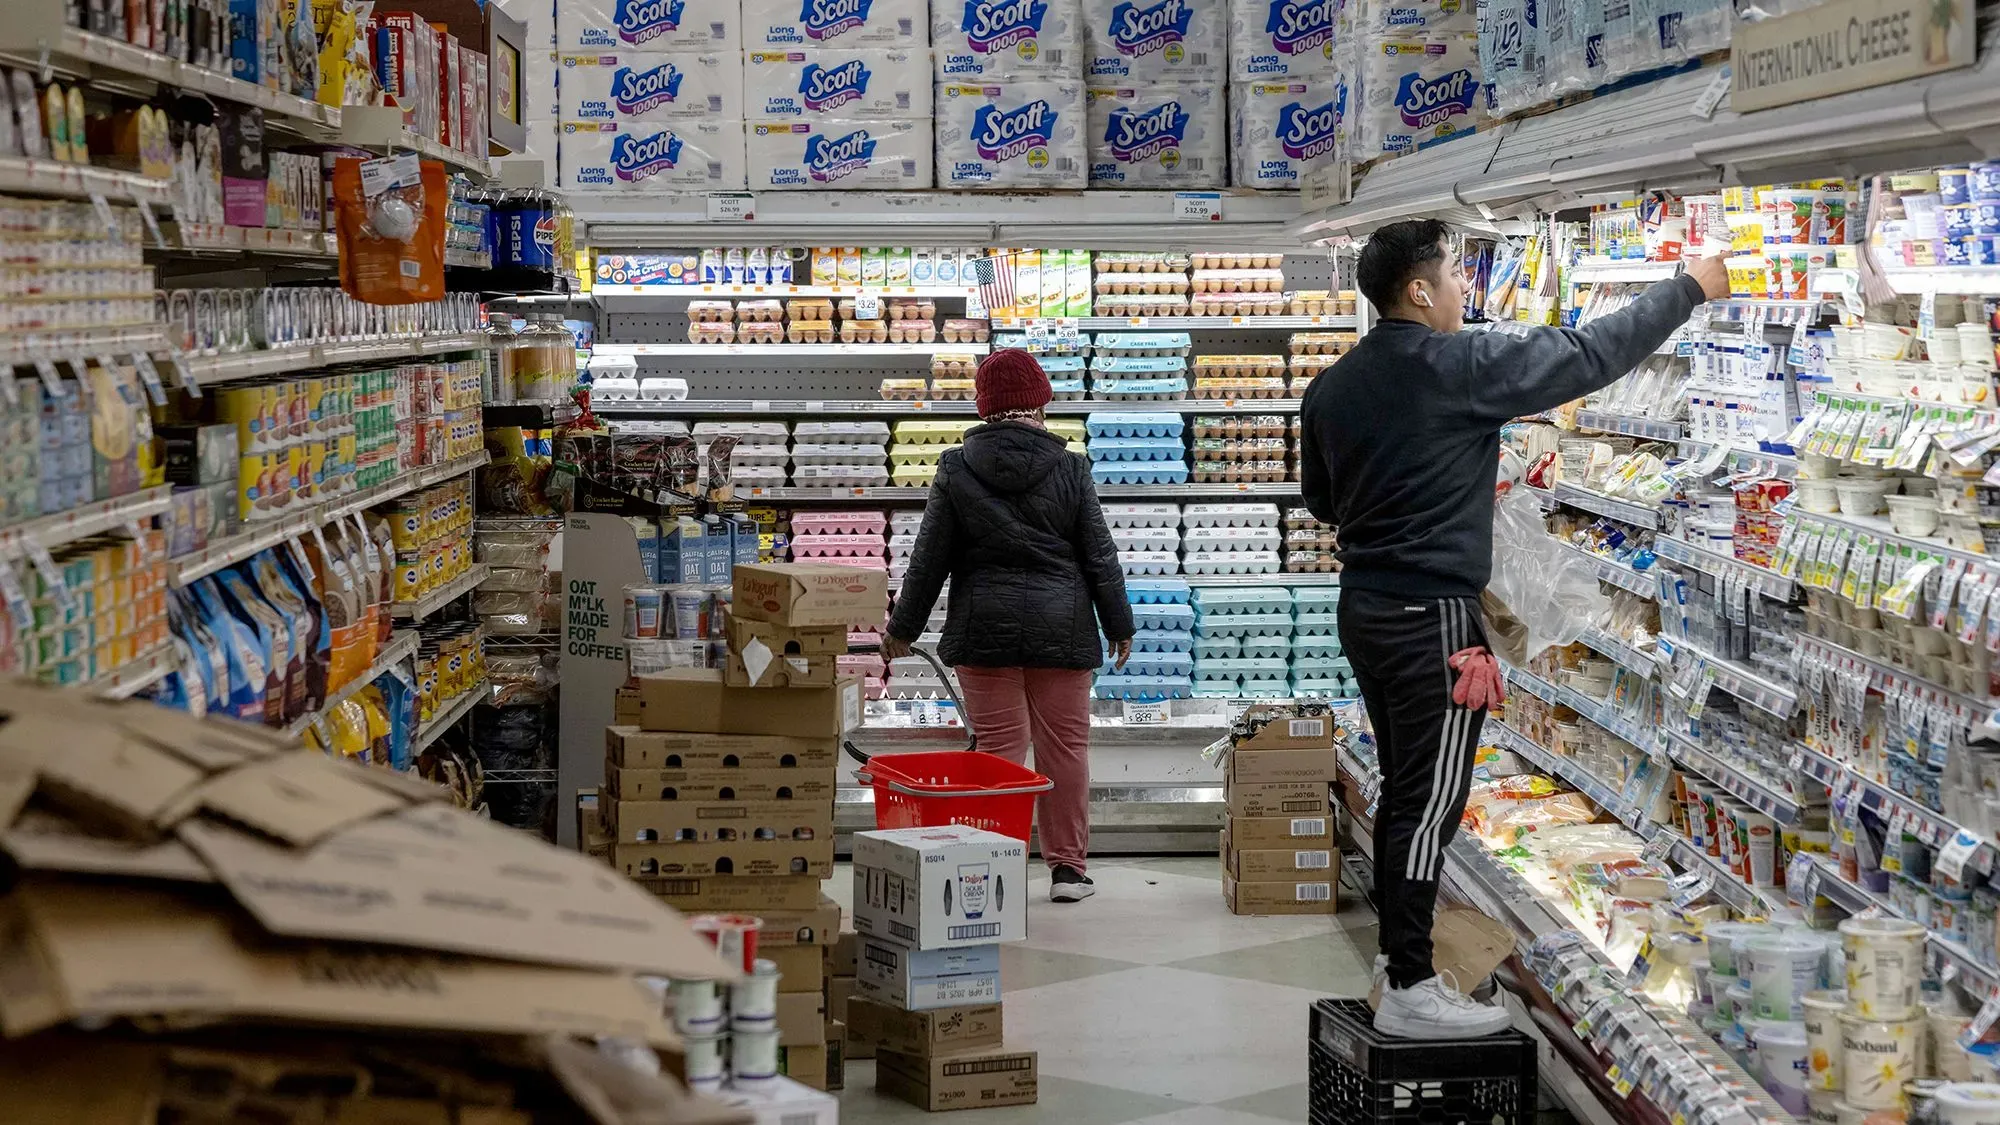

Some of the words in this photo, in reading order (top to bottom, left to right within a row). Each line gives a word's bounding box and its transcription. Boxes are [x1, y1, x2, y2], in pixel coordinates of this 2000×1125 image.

[622, 0, 672, 30] Scott
[1391, 8, 1417, 17] Long
[972, 0, 1034, 38] Scott
[1119, 0, 1181, 41] Scott
[1387, 15, 1426, 26] Lasting
[583, 28, 609, 39] Long
[634, 25, 662, 45] 1000
[769, 26, 795, 35] Long
[821, 21, 848, 41] 1000
[579, 37, 617, 47] Lasting
[766, 34, 803, 43] Lasting
[987, 32, 1017, 55] 1000
[1132, 35, 1165, 57] 1000
[1292, 33, 1323, 56] 1000
[1385, 46, 1398, 55] 36
[1737, 30, 1843, 91] INTERNATIONAL
[1847, 10, 1911, 66] CHEESE
[564, 58, 576, 67] 20
[946, 55, 974, 64] Long
[1094, 57, 1120, 67] Long
[1251, 55, 1278, 65] Long
[943, 64, 983, 74] Lasting
[1090, 66, 1129, 76] Lasting
[1248, 64, 1288, 74] Lasting
[620, 63, 673, 101] Scott
[809, 60, 861, 98] Scott
[949, 88, 960, 97] 36
[1405, 69, 1468, 112] Scott
[581, 100, 607, 110] Long
[632, 98, 660, 116] 1000
[768, 97, 794, 106] Long
[819, 95, 847, 114] 1000
[578, 109, 615, 119] Lasting
[765, 105, 803, 115] Lasting
[982, 100, 1046, 145] Scott
[1116, 101, 1178, 146] Scott
[1417, 108, 1450, 130] 1000
[564, 124, 576, 133] 20
[756, 127, 768, 135] 20
[1287, 108, 1334, 143] Sco
[1386, 134, 1412, 144] Long
[619, 130, 672, 168] Scott
[813, 130, 867, 168] Scott
[995, 140, 1029, 164] 1000
[1129, 141, 1161, 164] 1000
[1301, 137, 1334, 161] 1000
[955, 162, 983, 171] Long
[1089, 162, 1117, 173] Long
[1261, 160, 1288, 170] Long
[580, 167, 605, 176] Long
[630, 163, 660, 184] 1000
[773, 168, 799, 176] Long
[824, 166, 853, 183] 1000
[951, 171, 992, 181] Lasting
[1088, 171, 1126, 182] Lasting
[1258, 169, 1297, 180] Lasting
[576, 175, 614, 185] Lasting
[770, 176, 807, 185] Lasting
[511, 215, 522, 262] PEPSI
[642, 262, 669, 275] Crusts
[858, 299, 876, 309] $3.29
[1028, 330, 1046, 338] $5.69
[1059, 330, 1076, 338] $5.69
[681, 551, 704, 559] CALIFIA
[706, 549, 731, 557] CALIFIA
[736, 548, 758, 556] CALIFIA
[684, 563, 700, 576] OAT
[710, 562, 726, 574] OAT
[569, 580, 597, 595] OAT
[568, 611, 609, 628] MADE
[568, 626, 597, 642] FOR
[568, 641, 624, 661] COFFEE
[1012, 848, 1021, 857] OZ
[965, 874, 984, 884] Daisy
